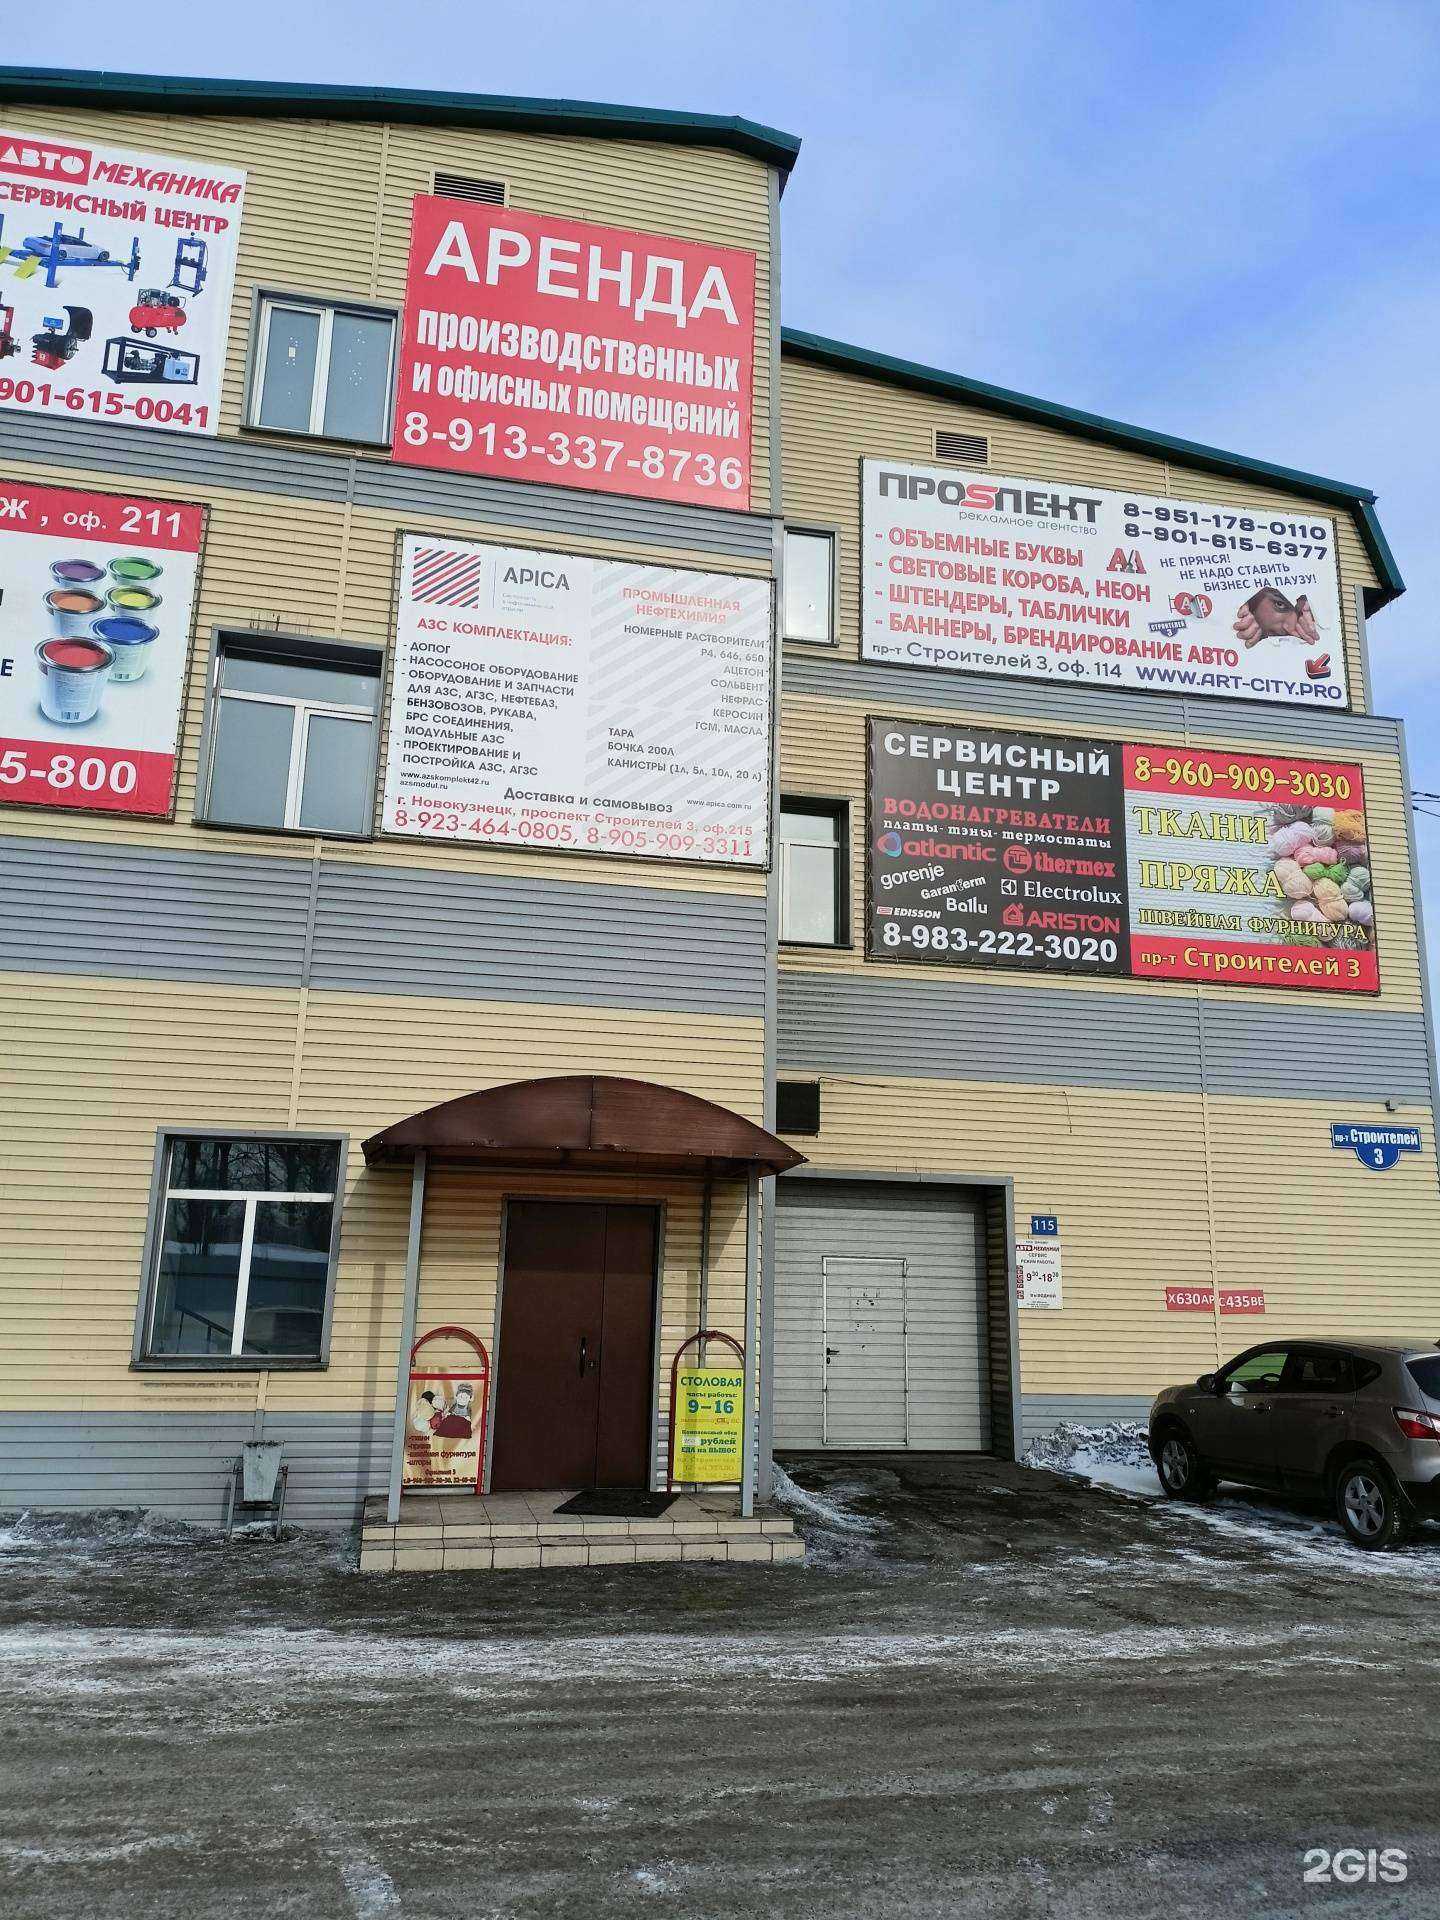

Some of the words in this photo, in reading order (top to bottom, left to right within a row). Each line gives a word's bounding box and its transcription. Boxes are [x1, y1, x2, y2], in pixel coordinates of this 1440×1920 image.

[0, 144, 85, 174] АВТО
[93, 160, 242, 203] МЕХАНИКА
[0, 182, 146, 222] СЕРВИСНЫЙ
[154, 208, 229, 234] ЦЕНТР
[424, 221, 739, 328] АРЕНДА
[404, 412, 743, 489] 8-913-337-8736
[120, 506, 182, 537] 211
[959, 510, 1033, 527] рекламное
[1037, 520, 1097, 535] агентство
[1124, 502, 1326, 541] 8-951-178-0110
[889, 527, 1009, 557] ОБЪЕМНЫЕ
[1015, 542, 1083, 567] БУКВЫ
[1124, 523, 1328, 560] 8-901-615-6377
[1160, 558, 1176, 568] НЕ
[1180, 554, 1230, 566] ПРЯЧСЯ!
[1180, 570, 1195, 580] НЕ
[1200, 567, 1234, 579] НАДО
[1238, 564, 1290, 575] СТАВИТЬ
[889, 555, 997, 585] СВЕТОВЫЕ
[1002, 569, 1089, 599] КОРОБА,
[1096, 579, 1150, 602] НЕОН
[1204, 580, 1250, 592] БИЗНЕС
[1255, 578, 1271, 588] НА
[1275, 575, 1317, 587] ПАУЗУ!
[623, 587, 741, 611] ПРОМЫШЛЕННАЯ
[889, 584, 1013, 617] ШТЕНДЕРЫ,
[1019, 598, 1130, 628] ТАБЛИЧКИ
[636, 604, 726, 624] НЕФТЕХИМИЯ
[417, 618, 447, 631] АЗС
[453, 622, 572, 646] КОМПЛЕКТАЦИЯ:
[624, 625, 683, 639] НОМЕРНЫЕ
[686, 632, 765, 648] РАСТВОРИТЕЛИ
[889, 613, 997, 644] БАННЕРЫ,
[1004, 625, 1183, 661] БРЕНДИРОВАНИЕ
[1188, 646, 1239, 667] АВТО
[410, 642, 450, 654] ДОПОГ
[745, 652, 764, 662] 650
[489, 665, 578, 682] ОБОРУДОВАНИЕ
[723, 665, 764, 677] АЦЕТОН
[873, 644, 902, 655] пр-т
[906, 642, 1032, 669] Строителей
[1058, 660, 1090, 677] оф.
[1094, 662, 1122, 678] 114
[1136, 666, 1342, 699] WWW.ART-CITY.PRO
[409, 670, 501, 688] ОБОРУДОВАНИЕ
[505, 681, 512, 689] И
[516, 682, 574, 696] ЗАПЧАСТИ
[711, 679, 764, 690] СОЛЬВЕНТ
[408, 684, 431, 694] ДЛЯ
[435, 687, 461, 698] АЗС,
[465, 691, 497, 703] АГЗС,
[501, 694, 558, 709] НЕФТЕБАЗ,
[721, 695, 763, 706] НЕФРАС
[407, 698, 486, 715] БЕНЗОВОЗОВ,
[490, 707, 537, 721] РУКАВА,
[713, 708, 763, 721] КЕРОСИН
[406, 712, 428, 722] БРС
[433, 714, 514, 732] СОЕДИНЕНИЯ,
[609, 728, 634, 738] ТАРА
[695, 722, 721, 733] ГСМ,
[724, 725, 763, 736] МАСЛА
[405, 726, 478, 742] МОДУЛЬНЫЕ
[481, 734, 504, 744] АЗС
[403, 740, 509, 759] ПРОЕКТИРОВАНИЕ
[512, 752, 520, 760] И
[608, 742, 644, 753] БОЧКА
[884, 733, 1110, 776] СЕРВИСНЫЙ
[403, 754, 475, 770] ПОСТРОЙКА
[479, 762, 505, 774] АЗС,
[510, 766, 538, 776] АГЗС
[607, 758, 666, 772] КАНИСТРЫ
[736, 771, 749, 779] 20
[937, 769, 1060, 800] ЦЕНТР
[1135, 756, 1350, 800] 8-960-909-3030
[504, 787, 574, 804] Доставка
[580, 797, 588, 805] и
[593, 798, 673, 813] самовывоз
[398, 796, 406, 805] г.
[412, 796, 516, 815] Новокузнецк,
[521, 808, 591, 822] проспект
[595, 813, 682, 830] Строителей
[884, 798, 1111, 834] ВОДОНАГРЕВАТЕЛИ
[1133, 806, 1268, 844] ТКАНИ
[587, 828, 752, 856] 8-905-909-3311
[903, 838, 997, 862] atlantic
[881, 863, 944, 890] gorenje
[1034, 852, 1116, 877] thermex
[1139, 859, 1286, 898] ПРЯЖА
[1024, 881, 1123, 904] Electrolux
[893, 907, 941, 919] EDISSON
[946, 897, 988, 914] Ballu
[1026, 911, 1119, 933] ARISTON
[1139, 908, 1242, 931] ШВЕЙНАЯ
[1248, 917, 1367, 941] ФУРНИТУРА
[884, 923, 1117, 963] 8-983-222-3020
[1141, 951, 1176, 966] пр-т
[1184, 947, 1340, 976] Строителей
[1347, 958, 1360, 978] 3
[1335, 1134, 1348, 1142] пр-т
[1351, 1129, 1418, 1144] Строителей
[1374, 1148, 1384, 1164] 3
[1034, 1221, 1054, 1230] 115
[681, 1377, 741, 1387] СТОЛОВАЯ
